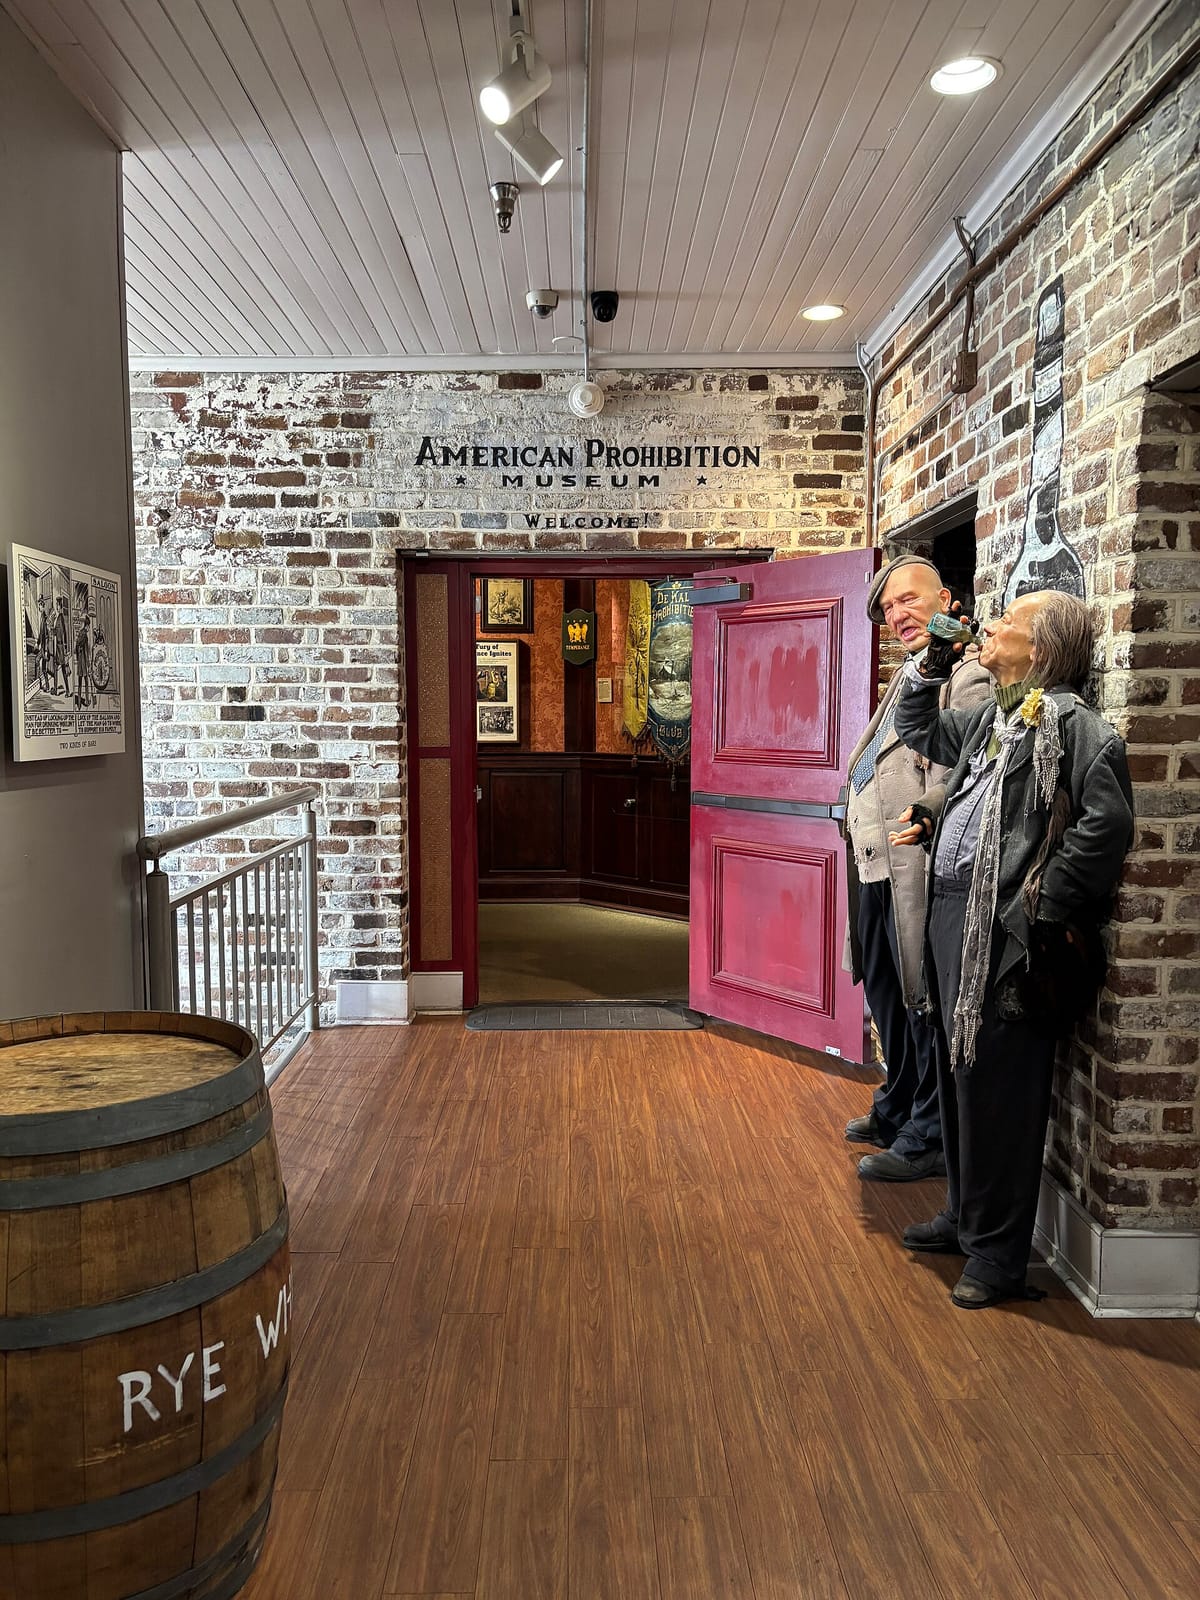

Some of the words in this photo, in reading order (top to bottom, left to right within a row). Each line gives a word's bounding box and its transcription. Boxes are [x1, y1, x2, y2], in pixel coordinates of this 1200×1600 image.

[414, 436, 574, 468] AMERICAN
[584, 438, 762, 468] PROHIBITION
[502, 474, 661, 488] MUSEUM
[524, 513, 651, 530] WELCOME!
[93, 579, 116, 590] SALOON
[657, 591, 669, 604] DE
[671, 590, 690, 603] KAL
[489, 650, 512, 658] Ignites
[492, 643, 499, 651] of
[659, 724, 683, 738] CLUB
[117, 1341, 227, 1433] RYE
[256, 1266, 293, 1360] WH
